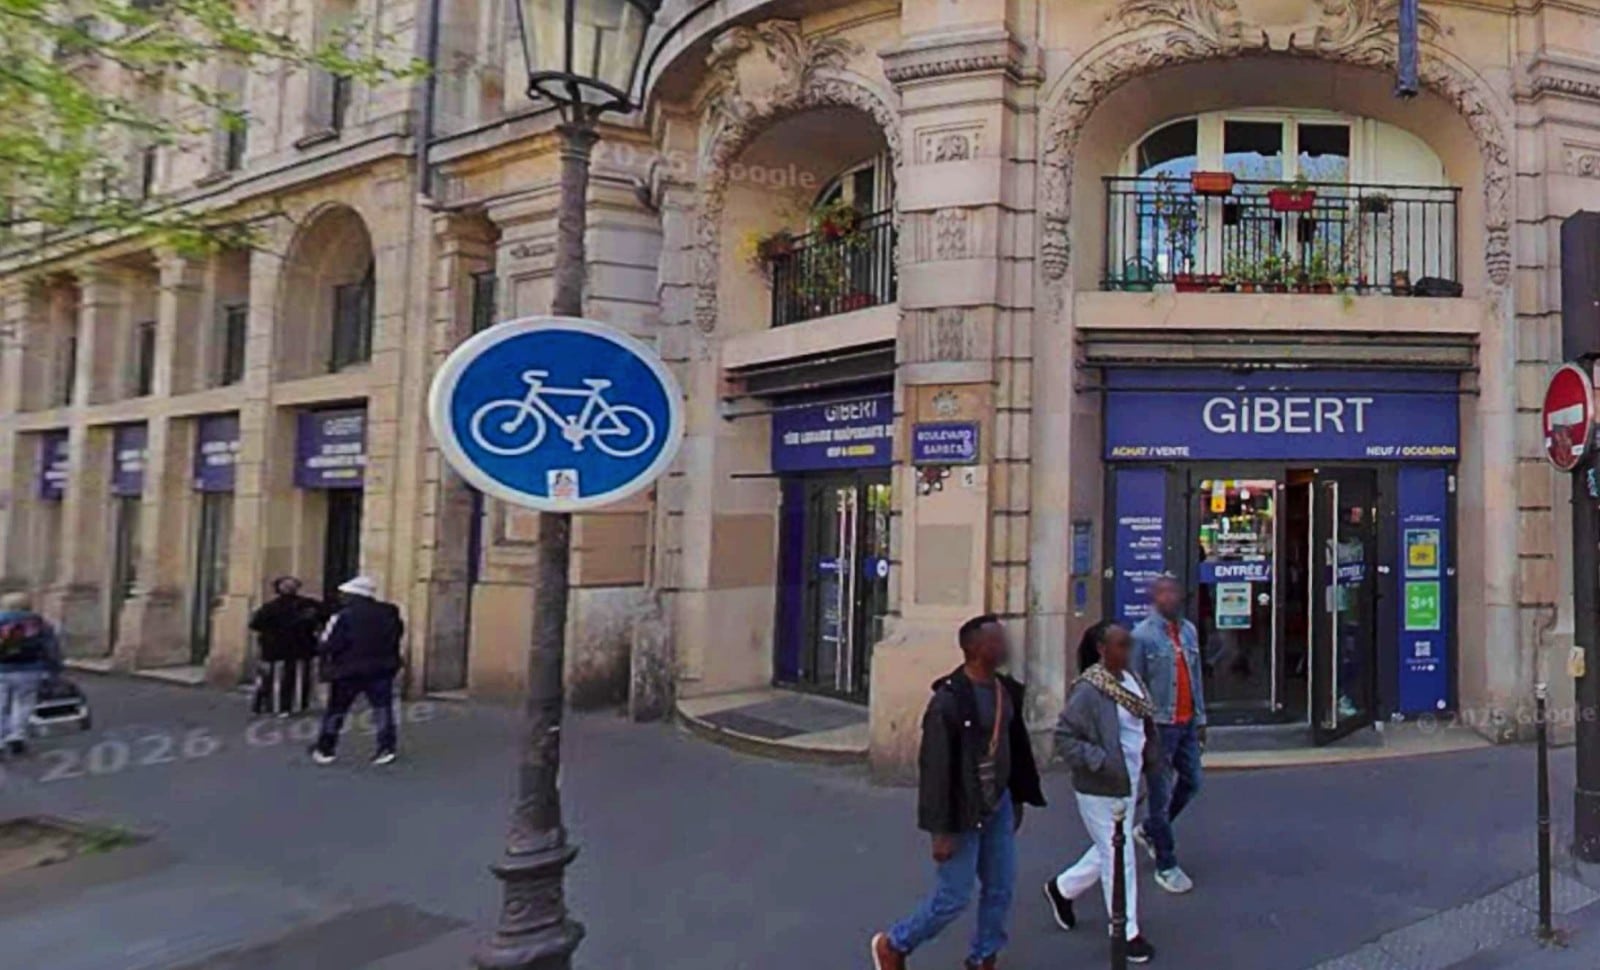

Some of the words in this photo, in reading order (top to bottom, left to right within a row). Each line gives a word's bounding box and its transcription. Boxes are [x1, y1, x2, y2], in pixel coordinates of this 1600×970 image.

[1111, 447, 1146, 456] ACHAT
[1156, 446, 1190, 457] VENTE
[1366, 446, 1394, 456] NEUF
[1402, 446, 1456, 456] OCCASION
[1214, 563, 1263, 576] ENTRÉE
